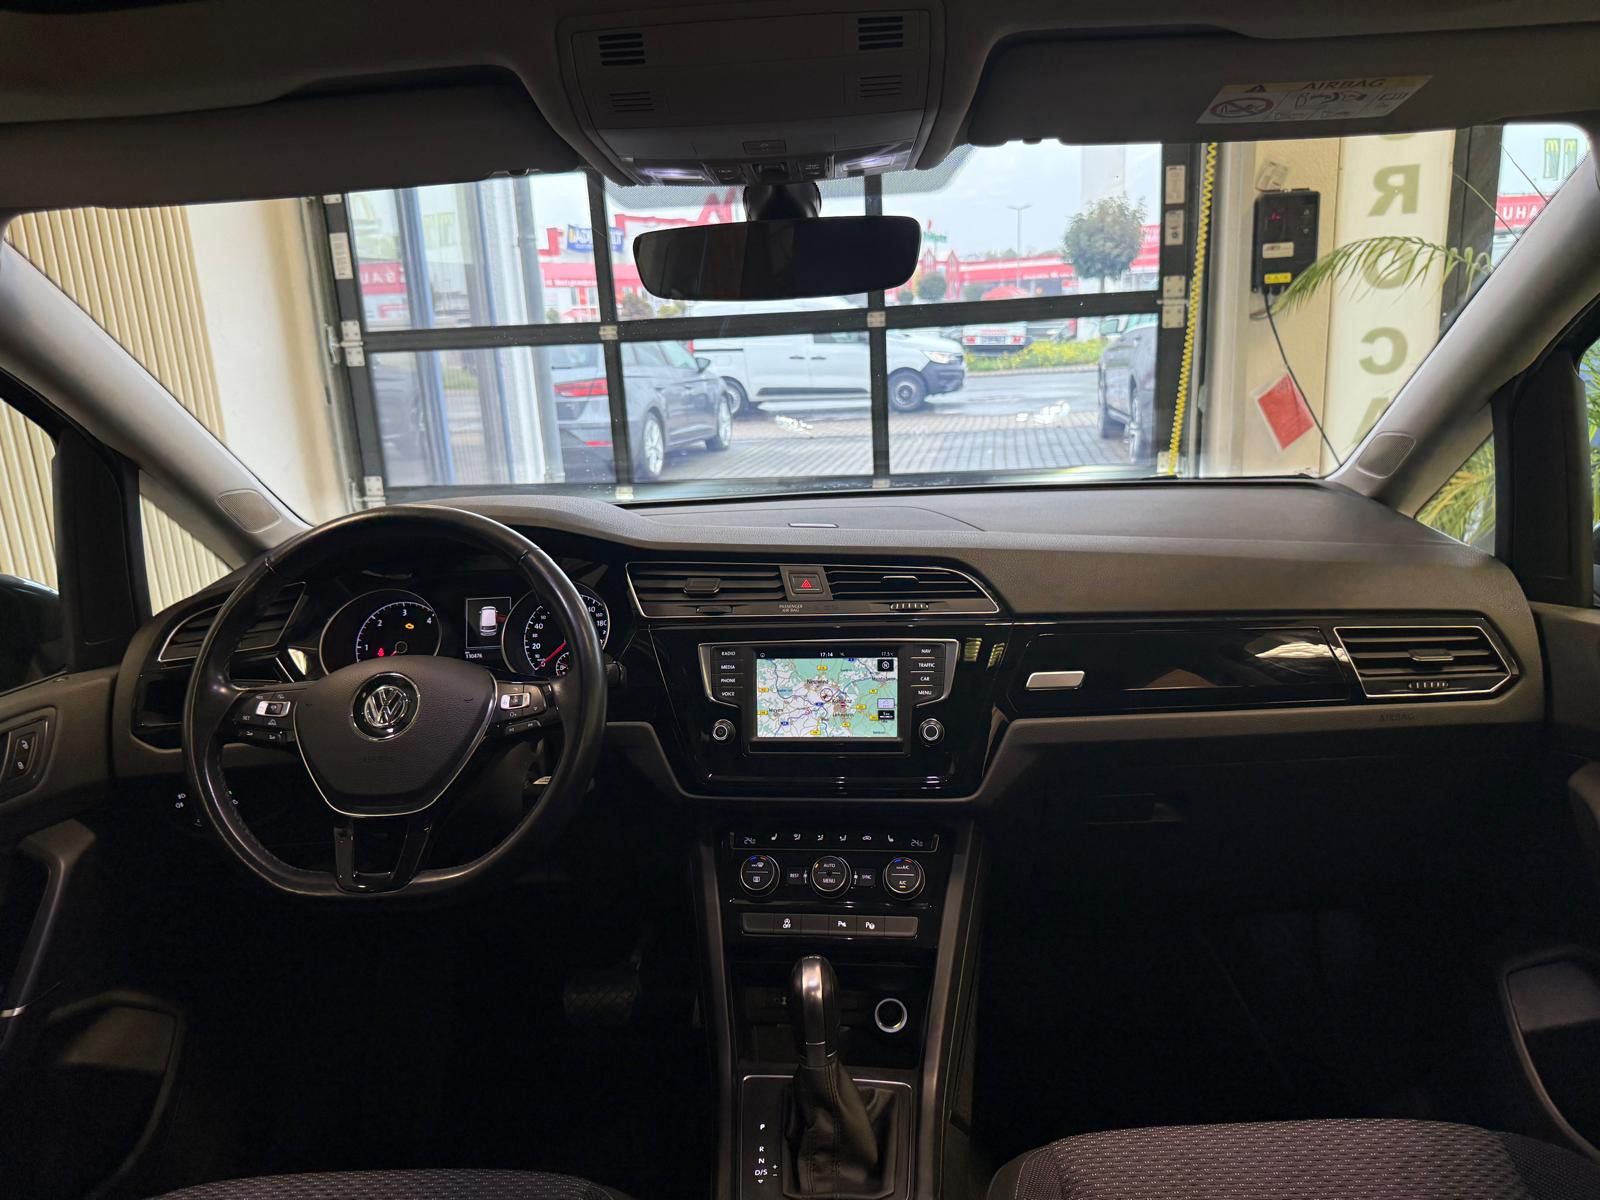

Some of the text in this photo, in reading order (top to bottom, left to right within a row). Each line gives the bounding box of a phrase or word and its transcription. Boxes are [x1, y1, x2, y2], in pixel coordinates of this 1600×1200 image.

[1301, 79, 1386, 90] AIRBAG
[402, 609, 407, 617] 3
[377, 619, 383, 627] 2
